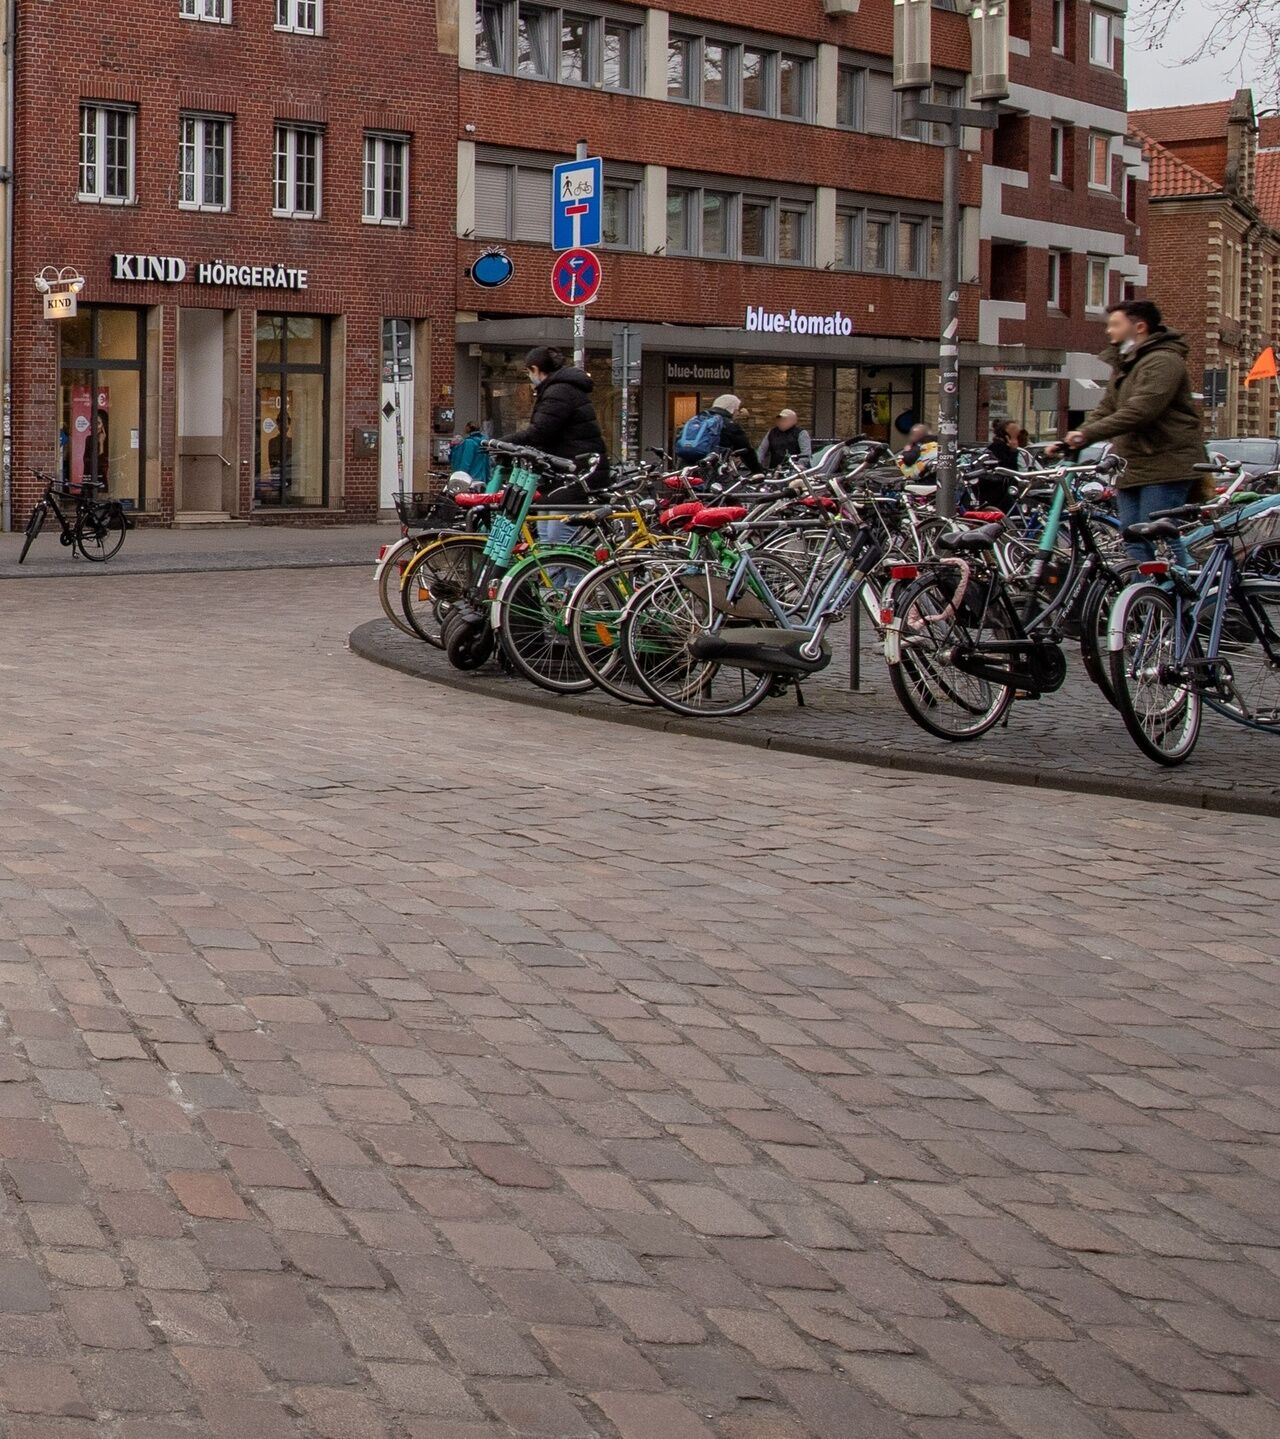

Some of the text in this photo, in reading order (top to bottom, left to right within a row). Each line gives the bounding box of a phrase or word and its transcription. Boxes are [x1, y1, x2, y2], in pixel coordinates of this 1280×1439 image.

[114, 253, 308, 289] KIND HÖRGERÄTE
[48, 298, 71, 309] KIND
[745, 305, 852, 336] blue-tomato
[667, 363, 730, 379] blue-tomato
